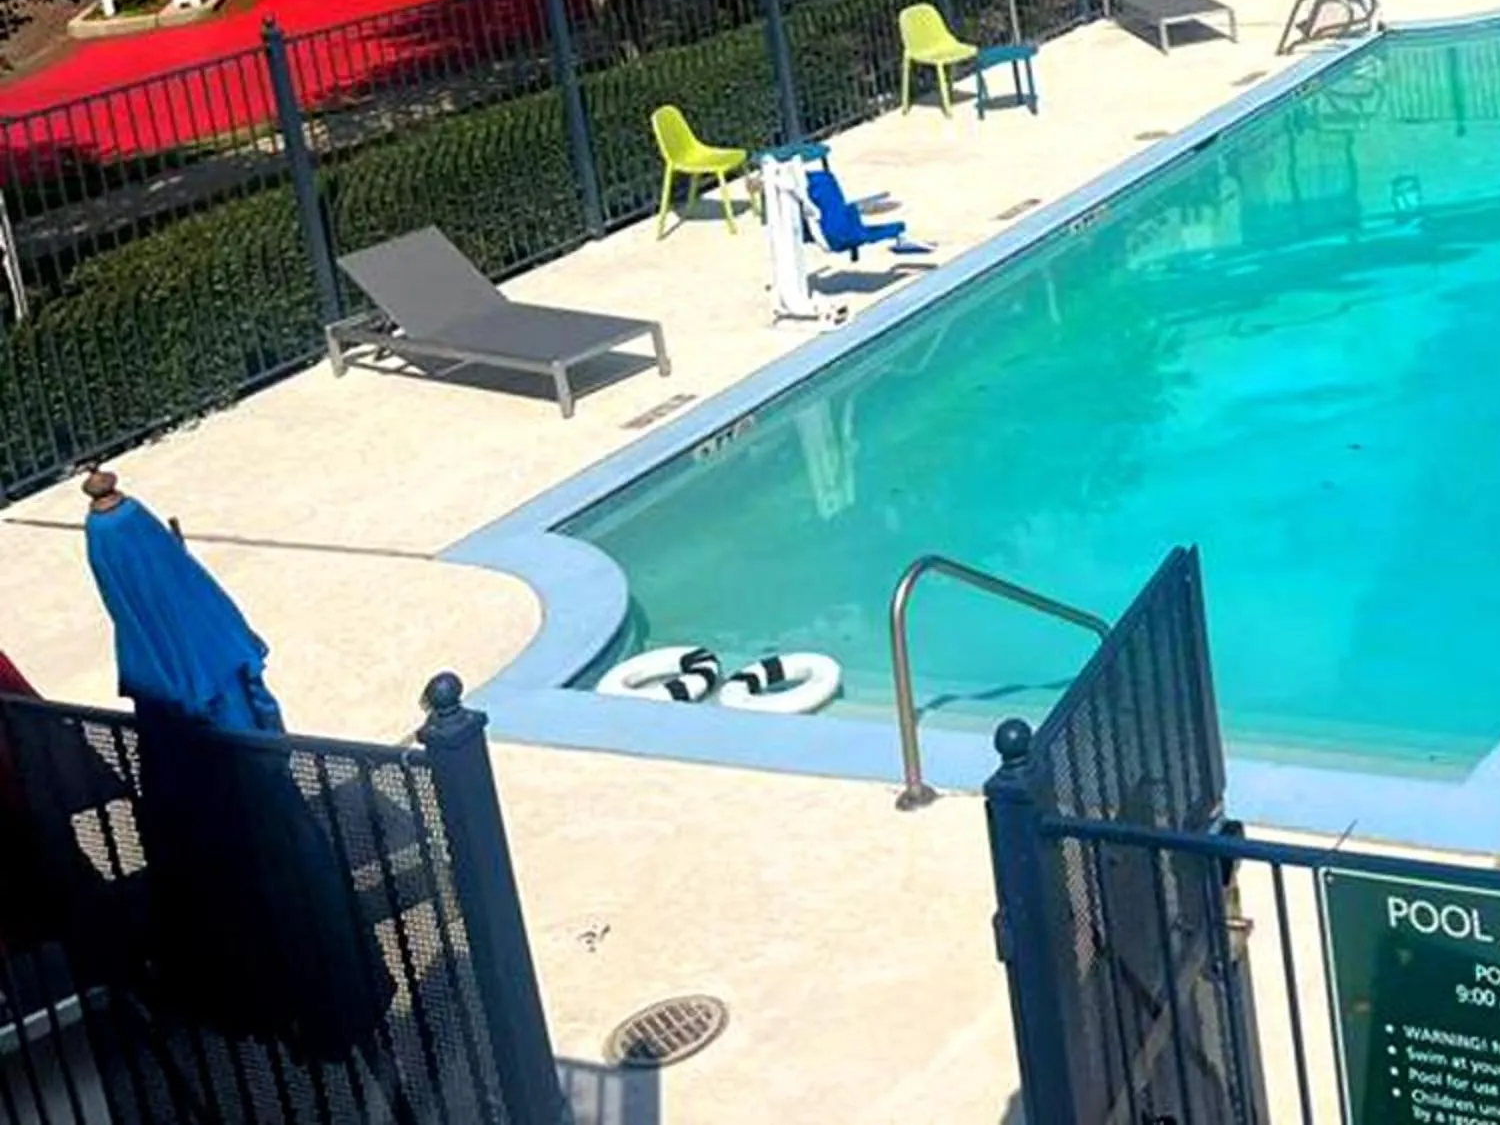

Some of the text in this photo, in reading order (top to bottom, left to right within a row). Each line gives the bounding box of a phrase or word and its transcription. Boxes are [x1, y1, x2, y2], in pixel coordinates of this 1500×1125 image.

[1386, 895, 1495, 943] POOL
[1455, 983, 1496, 1007] 9:00
[1405, 1044, 1449, 1066] Swim
[1451, 1056, 1468, 1071] at
[1408, 1066, 1443, 1087] Pool
[1445, 1072, 1470, 1091] for
[1472, 1081, 1499, 1097] use
[1411, 1088, 1475, 1113] Children
